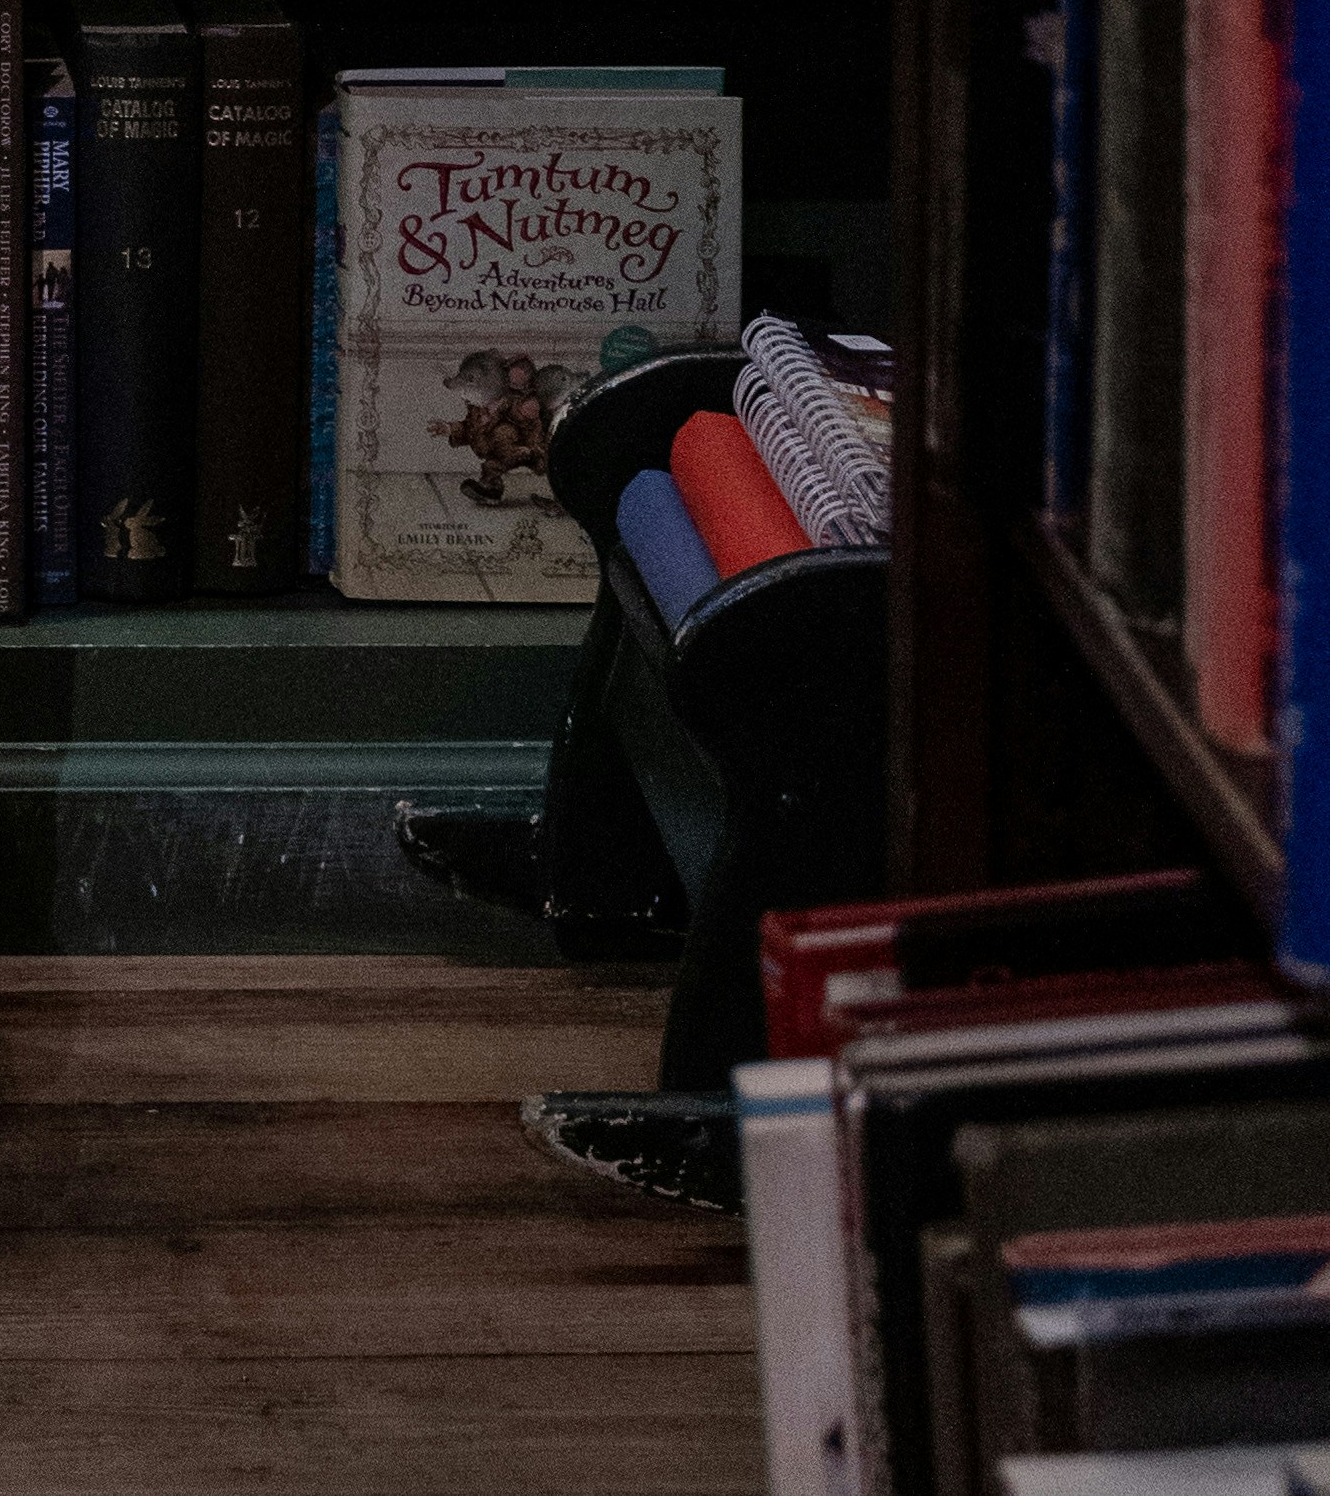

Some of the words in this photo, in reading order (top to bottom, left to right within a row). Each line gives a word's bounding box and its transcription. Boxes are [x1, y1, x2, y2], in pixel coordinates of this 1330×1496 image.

[398, 151, 678, 221] Tumtum
[399, 215, 451, 283] &
[457, 198, 682, 283] Nutmeg
[403, 284, 487, 311] Beyond
[490, 290, 605, 310] Nutmouse
[609, 288, 667, 314] Hall
[479, 261, 615, 290] Adventures
